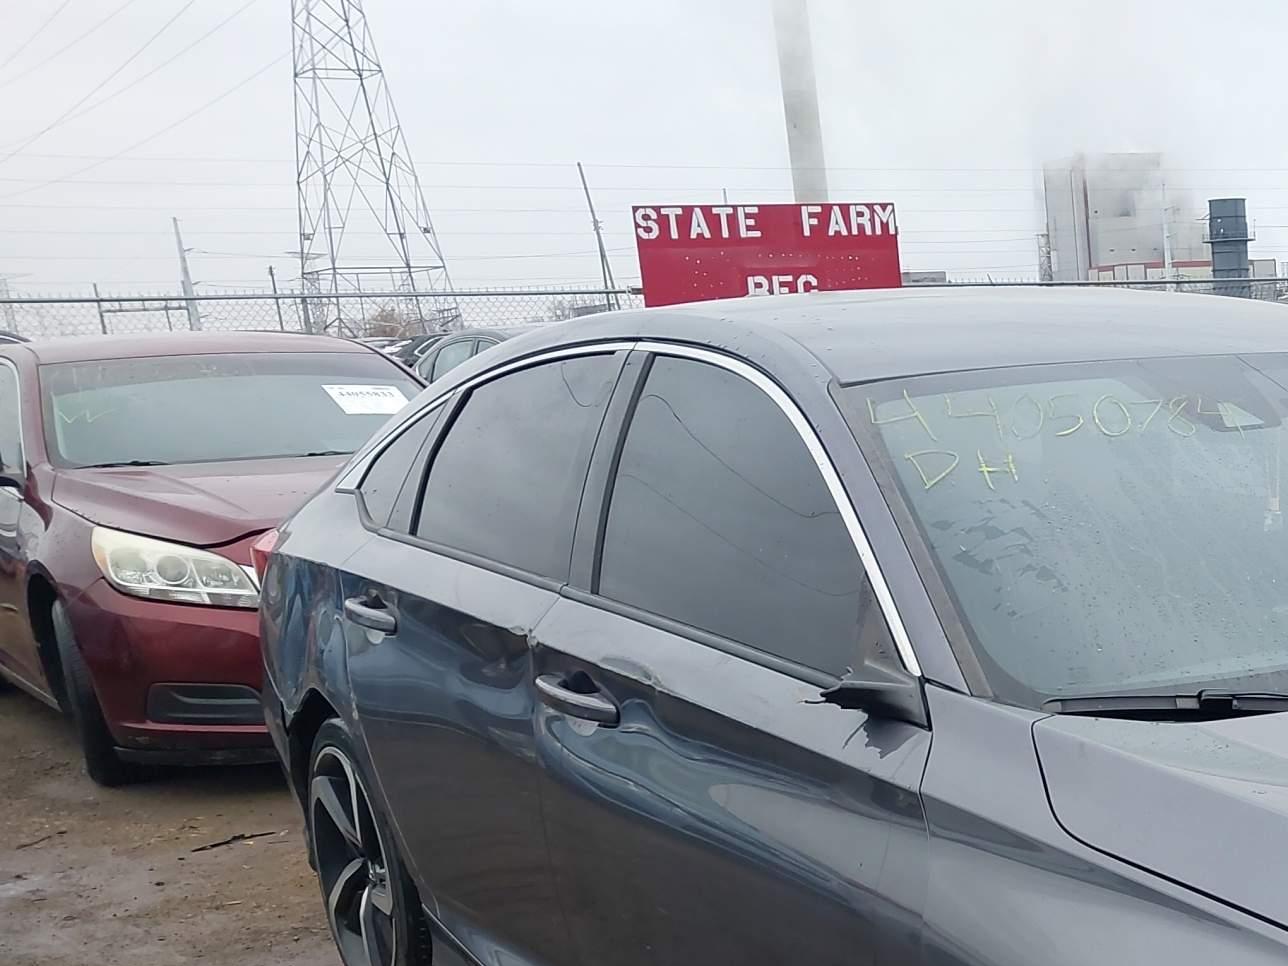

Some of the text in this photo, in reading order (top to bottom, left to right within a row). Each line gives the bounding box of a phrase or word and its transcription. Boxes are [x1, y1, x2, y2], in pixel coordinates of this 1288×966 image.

[634, 204, 897, 240] STATE FARM
[865, 389, 1247, 441] 44050784
